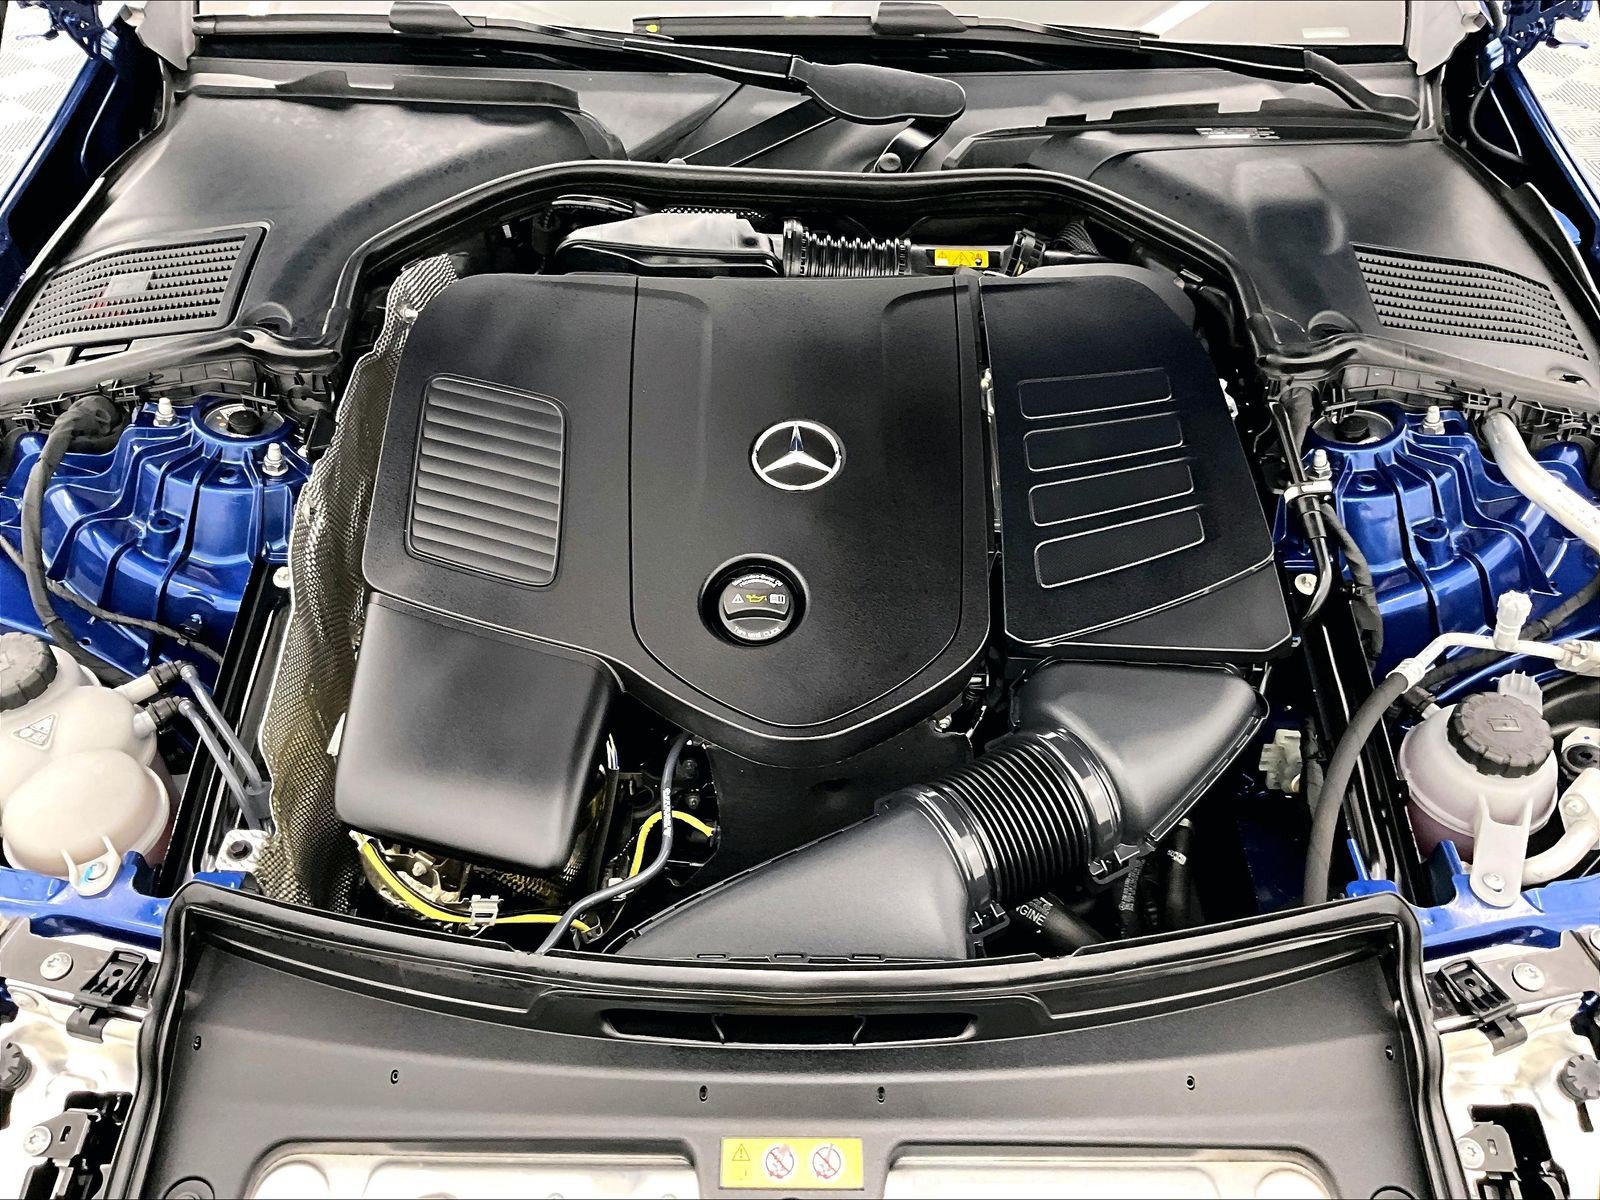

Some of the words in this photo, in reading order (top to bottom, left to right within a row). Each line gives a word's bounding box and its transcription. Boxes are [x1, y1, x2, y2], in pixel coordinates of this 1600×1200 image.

[733, 625, 747, 637] Turn
[763, 626, 782, 637] CLICK
[1016, 903, 1047, 927] GINE
